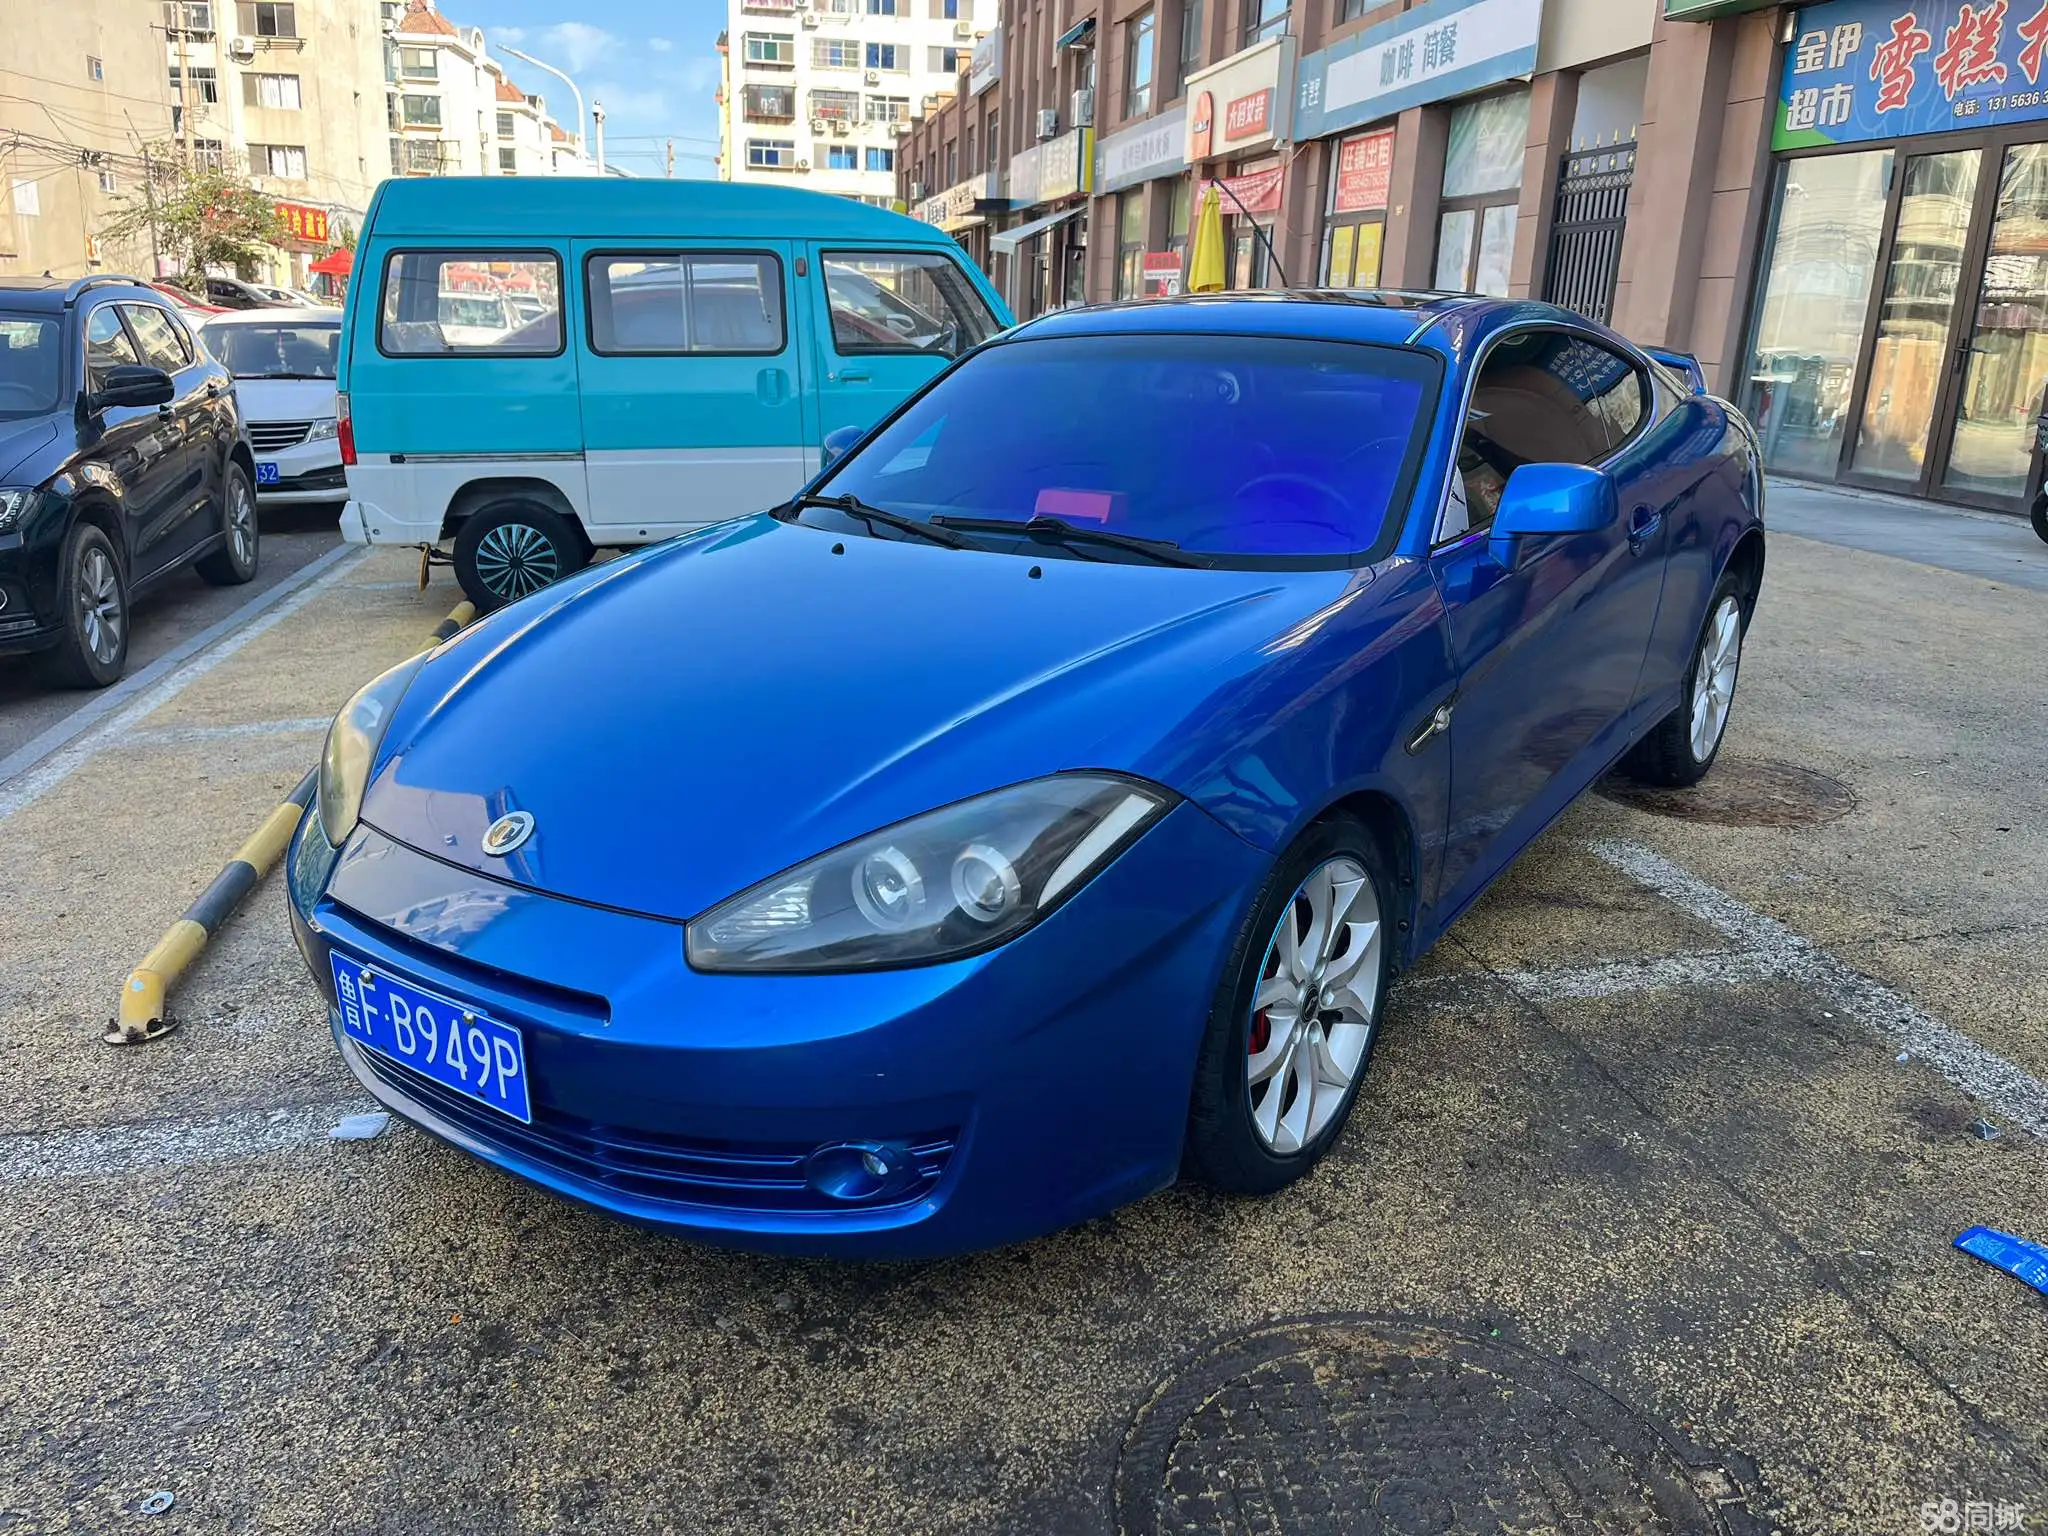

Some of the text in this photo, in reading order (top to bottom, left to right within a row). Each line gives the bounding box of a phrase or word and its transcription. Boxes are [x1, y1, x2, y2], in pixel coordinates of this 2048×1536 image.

[1379, 20, 1458, 88] 咖啡 简餐
[1793, 22, 1864, 75] 金伊
[1227, 94, 1267, 131] 大码女装
[1785, 83, 1854, 132] 超市
[1987, 96, 2007, 111] 131
[2010, 91, 2040, 108] 5636
[256, 465, 277, 481] 32
